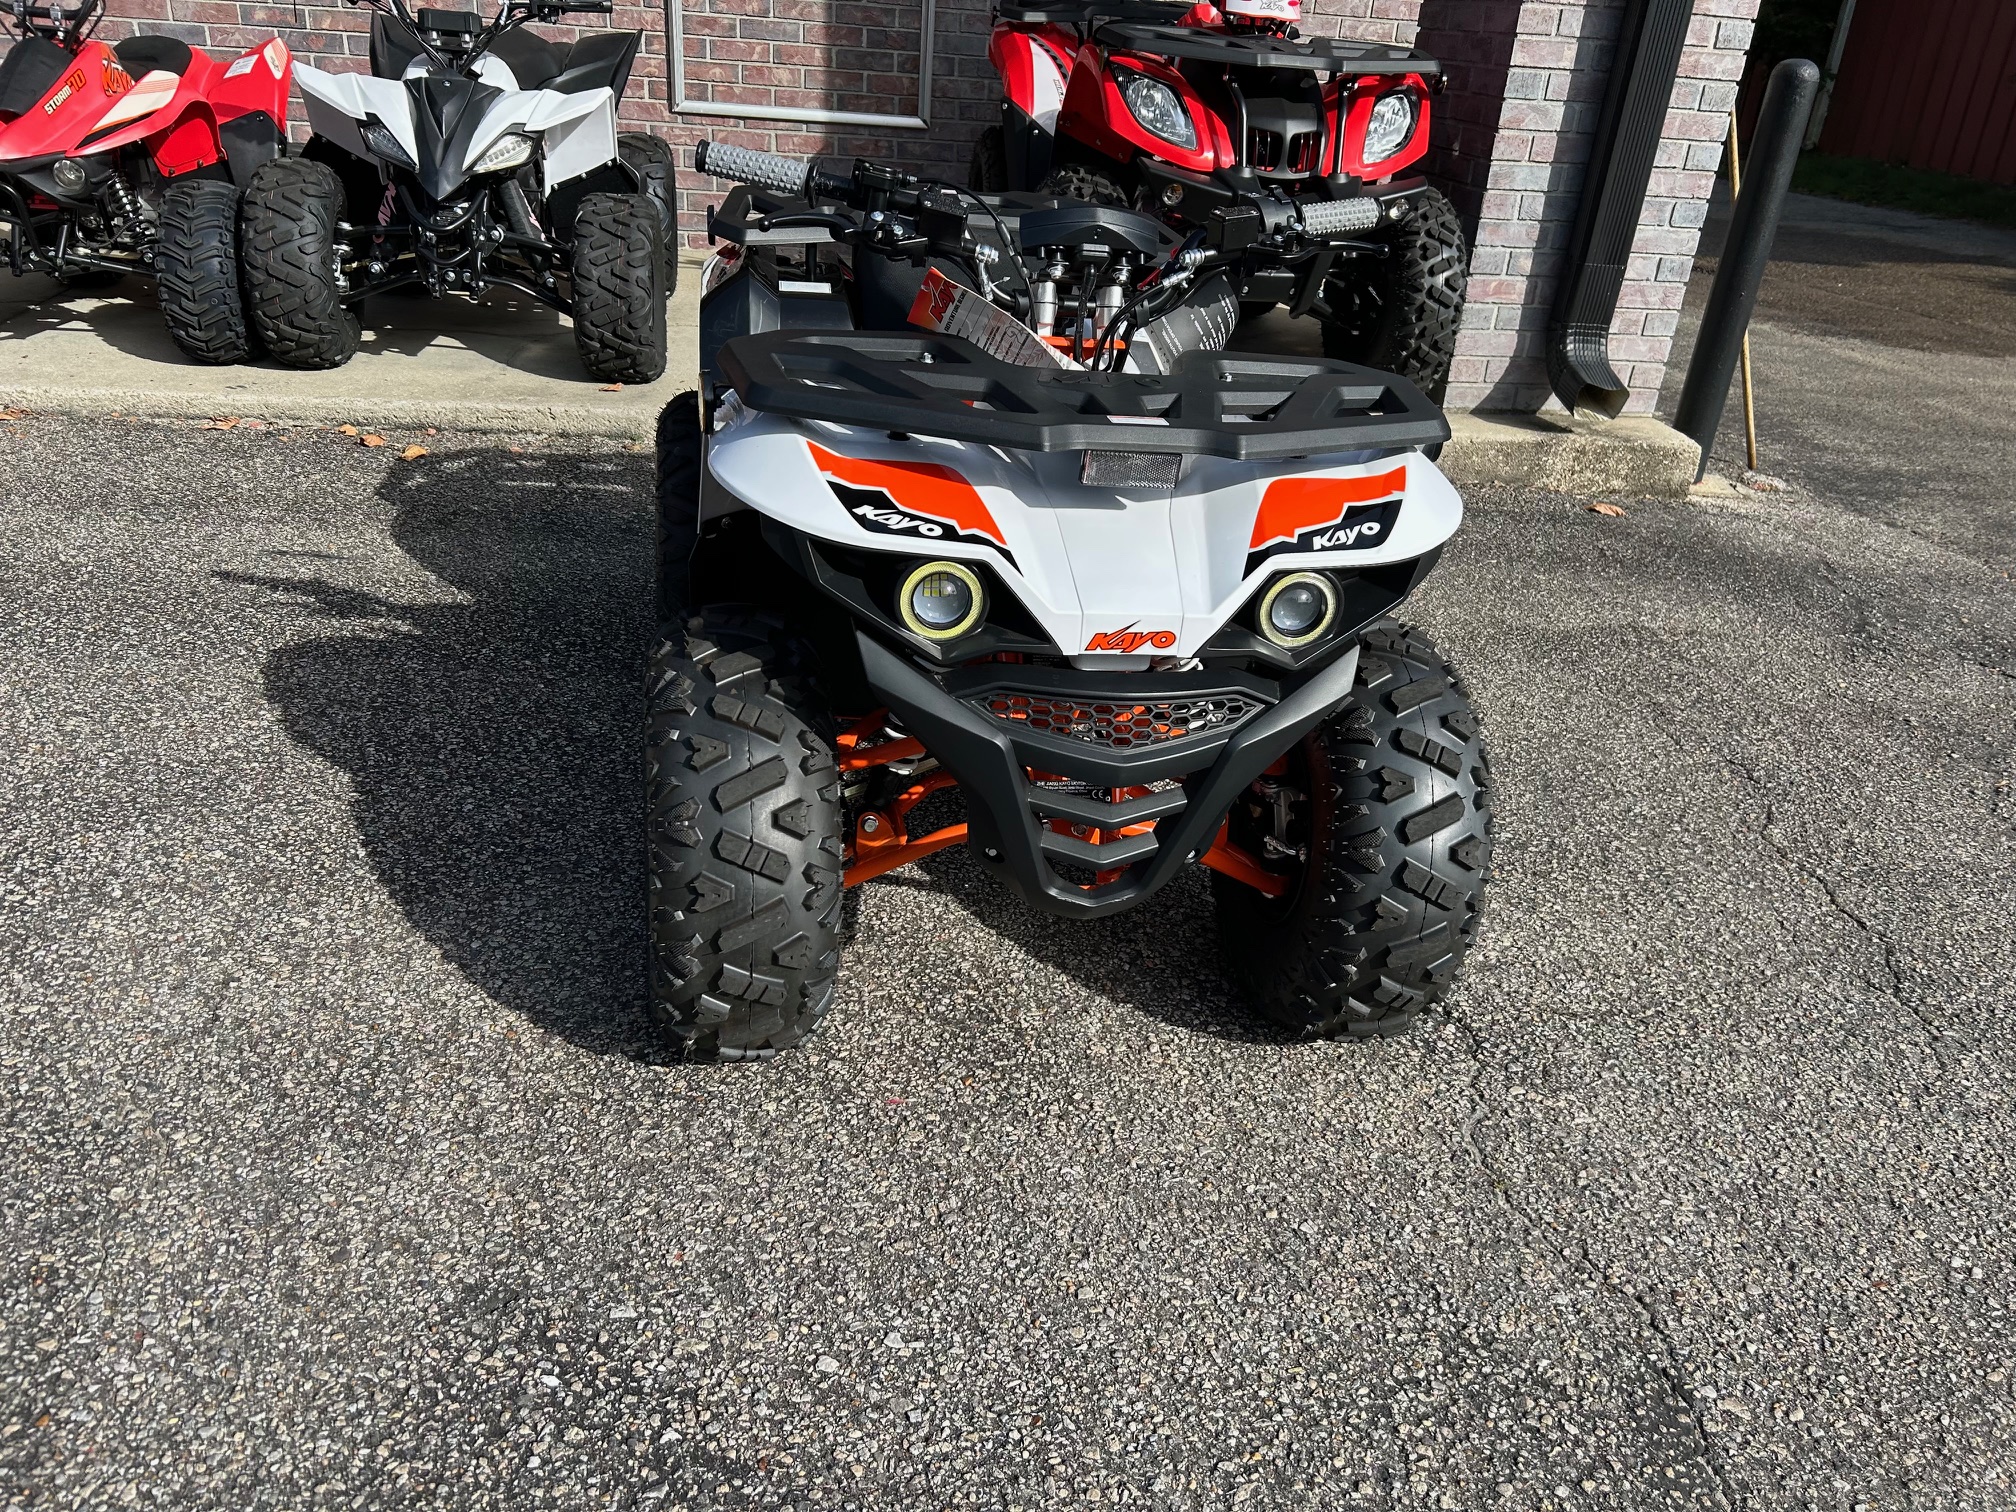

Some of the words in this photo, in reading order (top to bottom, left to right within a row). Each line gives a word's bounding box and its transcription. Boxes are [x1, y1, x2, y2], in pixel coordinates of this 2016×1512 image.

[43, 84, 72, 115] STORM
[65, 68, 87, 92] 70
[101, 59, 135, 97] KAY
[852, 504, 943, 537] KAYO
[1312, 521, 1381, 550] KAYO
[1084, 620, 1177, 653] KAYO
